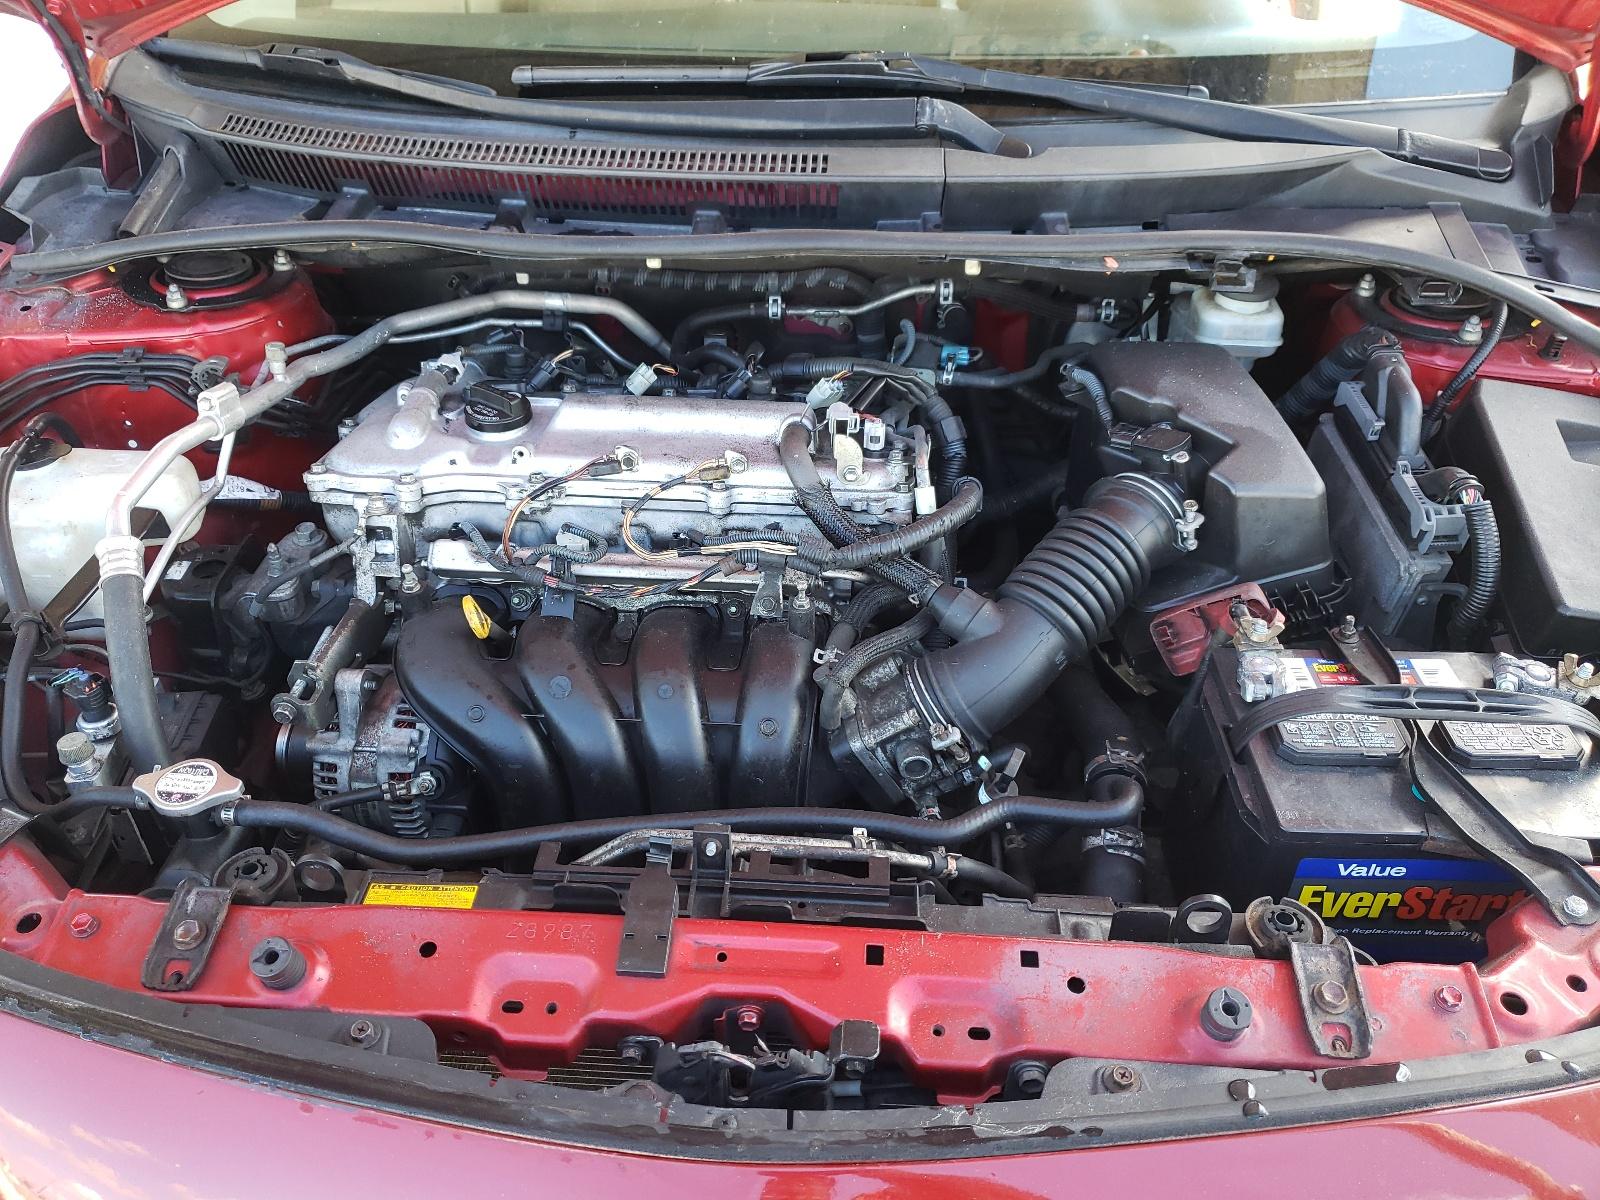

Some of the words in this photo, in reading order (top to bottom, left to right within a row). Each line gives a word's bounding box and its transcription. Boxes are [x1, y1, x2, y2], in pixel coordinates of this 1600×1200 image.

[1337, 863, 1407, 877] Value
[1352, 927, 1422, 936] Replacement
[1424, 929, 1472, 938] Warranty
